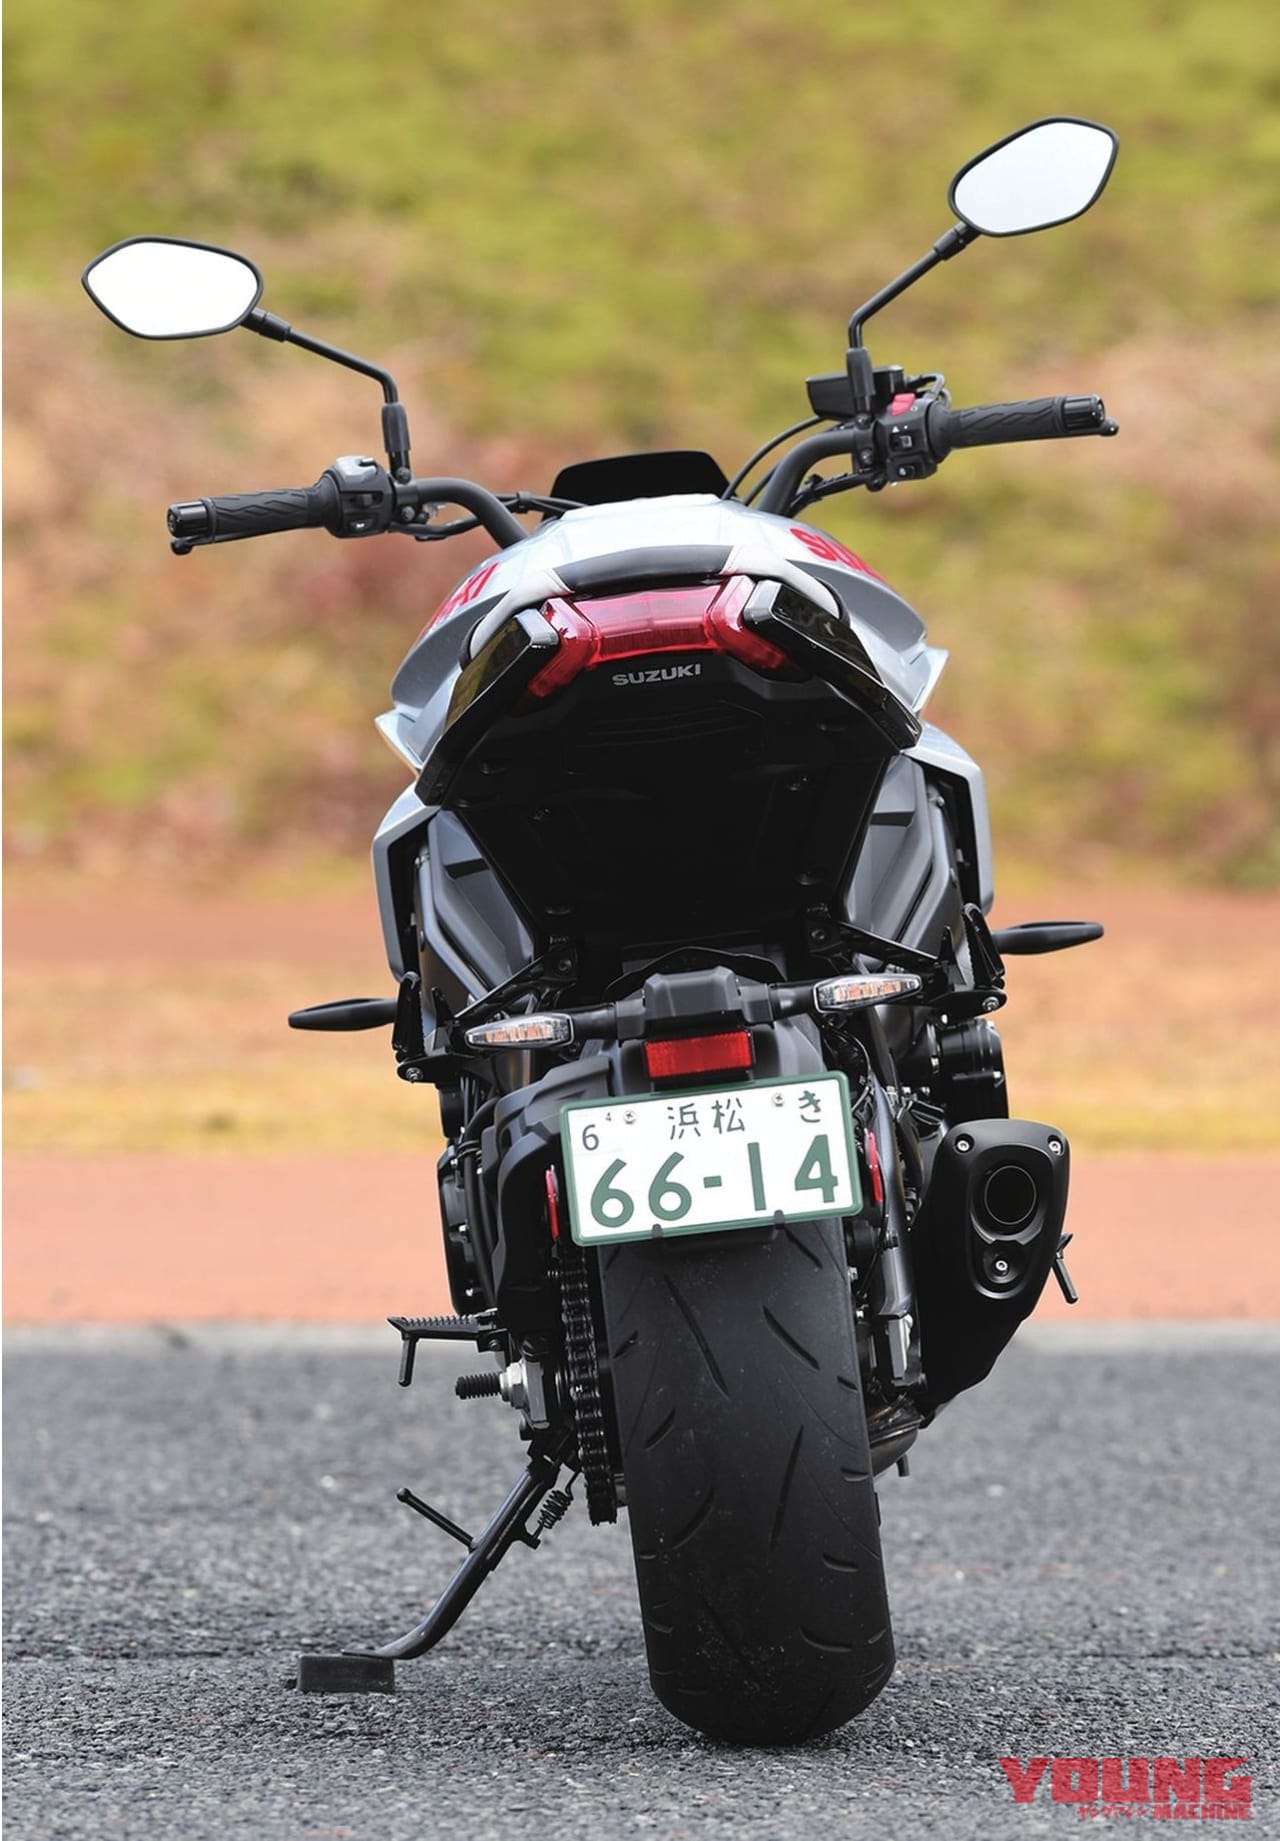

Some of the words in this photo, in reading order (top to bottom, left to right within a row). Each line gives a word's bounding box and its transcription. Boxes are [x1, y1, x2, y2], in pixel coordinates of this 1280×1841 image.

[612, 663, 701, 686] SUZUKI
[667, 1098, 745, 1140] 浜松
[798, 1090, 821, 1124] き
[582, 1124, 600, 1151] 6
[590, 1134, 839, 1228] 66-14
